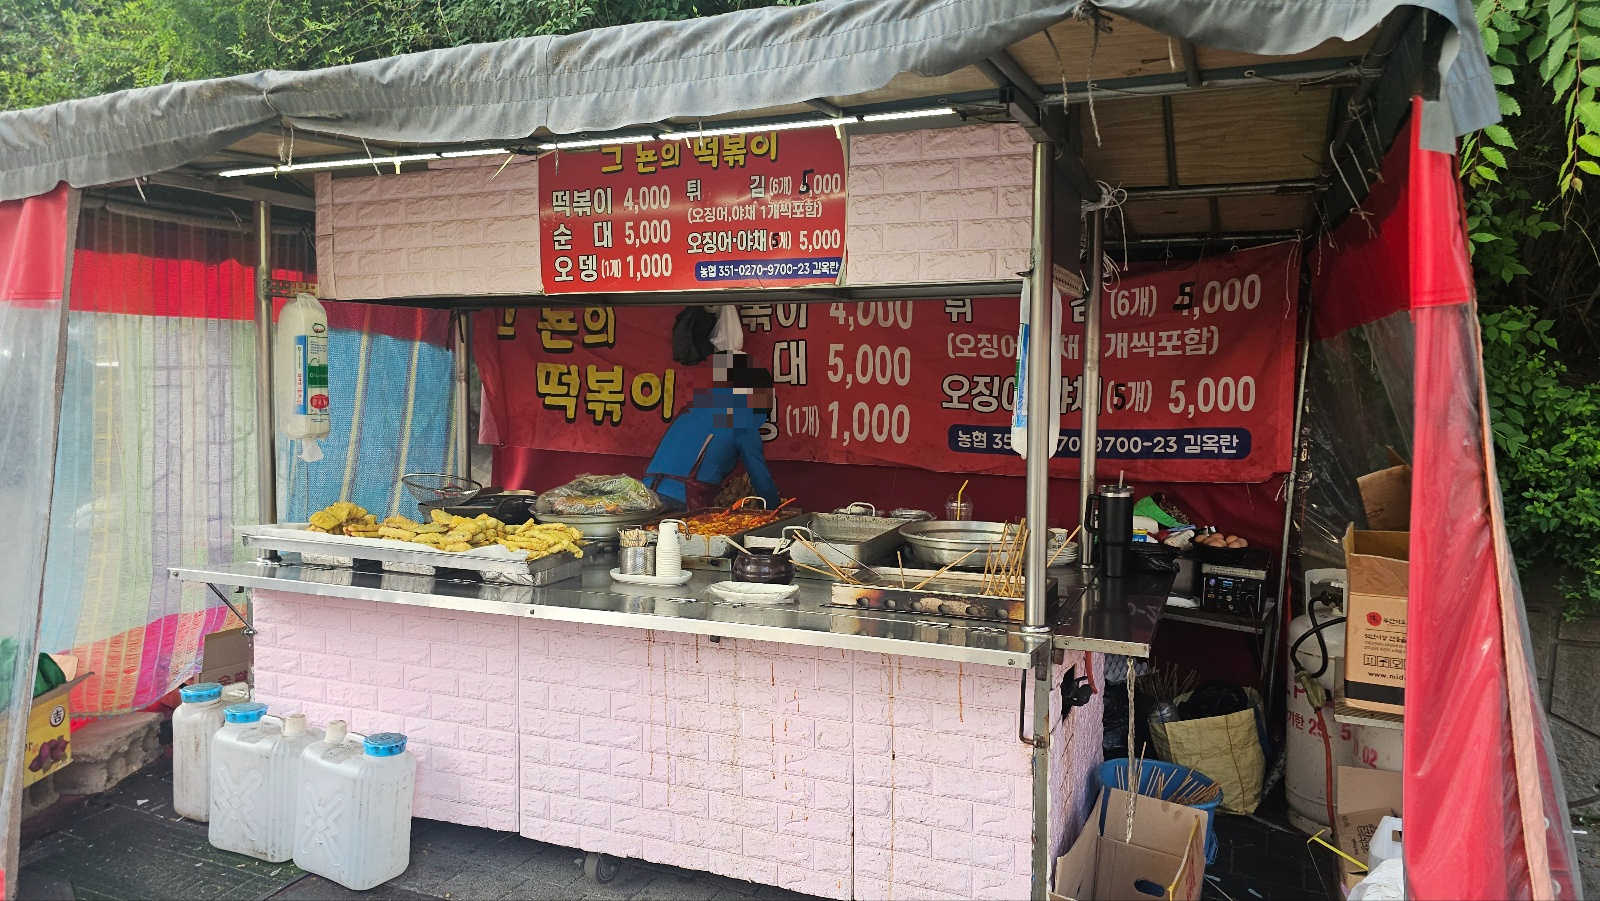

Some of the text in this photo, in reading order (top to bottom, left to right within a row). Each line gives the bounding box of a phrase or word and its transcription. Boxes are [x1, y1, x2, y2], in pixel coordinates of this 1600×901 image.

[602, 147, 623, 173] 그
[693, 132, 778, 168] 떡볶이
[552, 185, 671, 217] 떡볶이 4,000
[686, 179, 701, 201] 튀
[750, 174, 766, 198] 김
[769, 175, 792, 196] (6개)
[553, 220, 671, 250] 순 대 5,000
[799, 229, 841, 253] 5,000
[554, 253, 672, 282] 오 뎅 (1개) 1,000
[700, 261, 840, 279] 농협 351-0270-9700-23 김옥란
[830, 301, 913, 332] 4,000
[1109, 284, 1157, 320] (6개)
[1104, 326, 1219, 359] 개씩포함)
[773, 339, 911, 390] 대 5,000
[536, 362, 678, 425] 떡볶이
[1168, 375, 1256, 418] 5,000
[786, 404, 820, 438] (1개)
[828, 401, 911, 447] 1,000
[957, 430, 987, 450] 농협
[1183, 434, 1239, 455] 김옥란
[1368, 672, 1406, 681] www.mid
